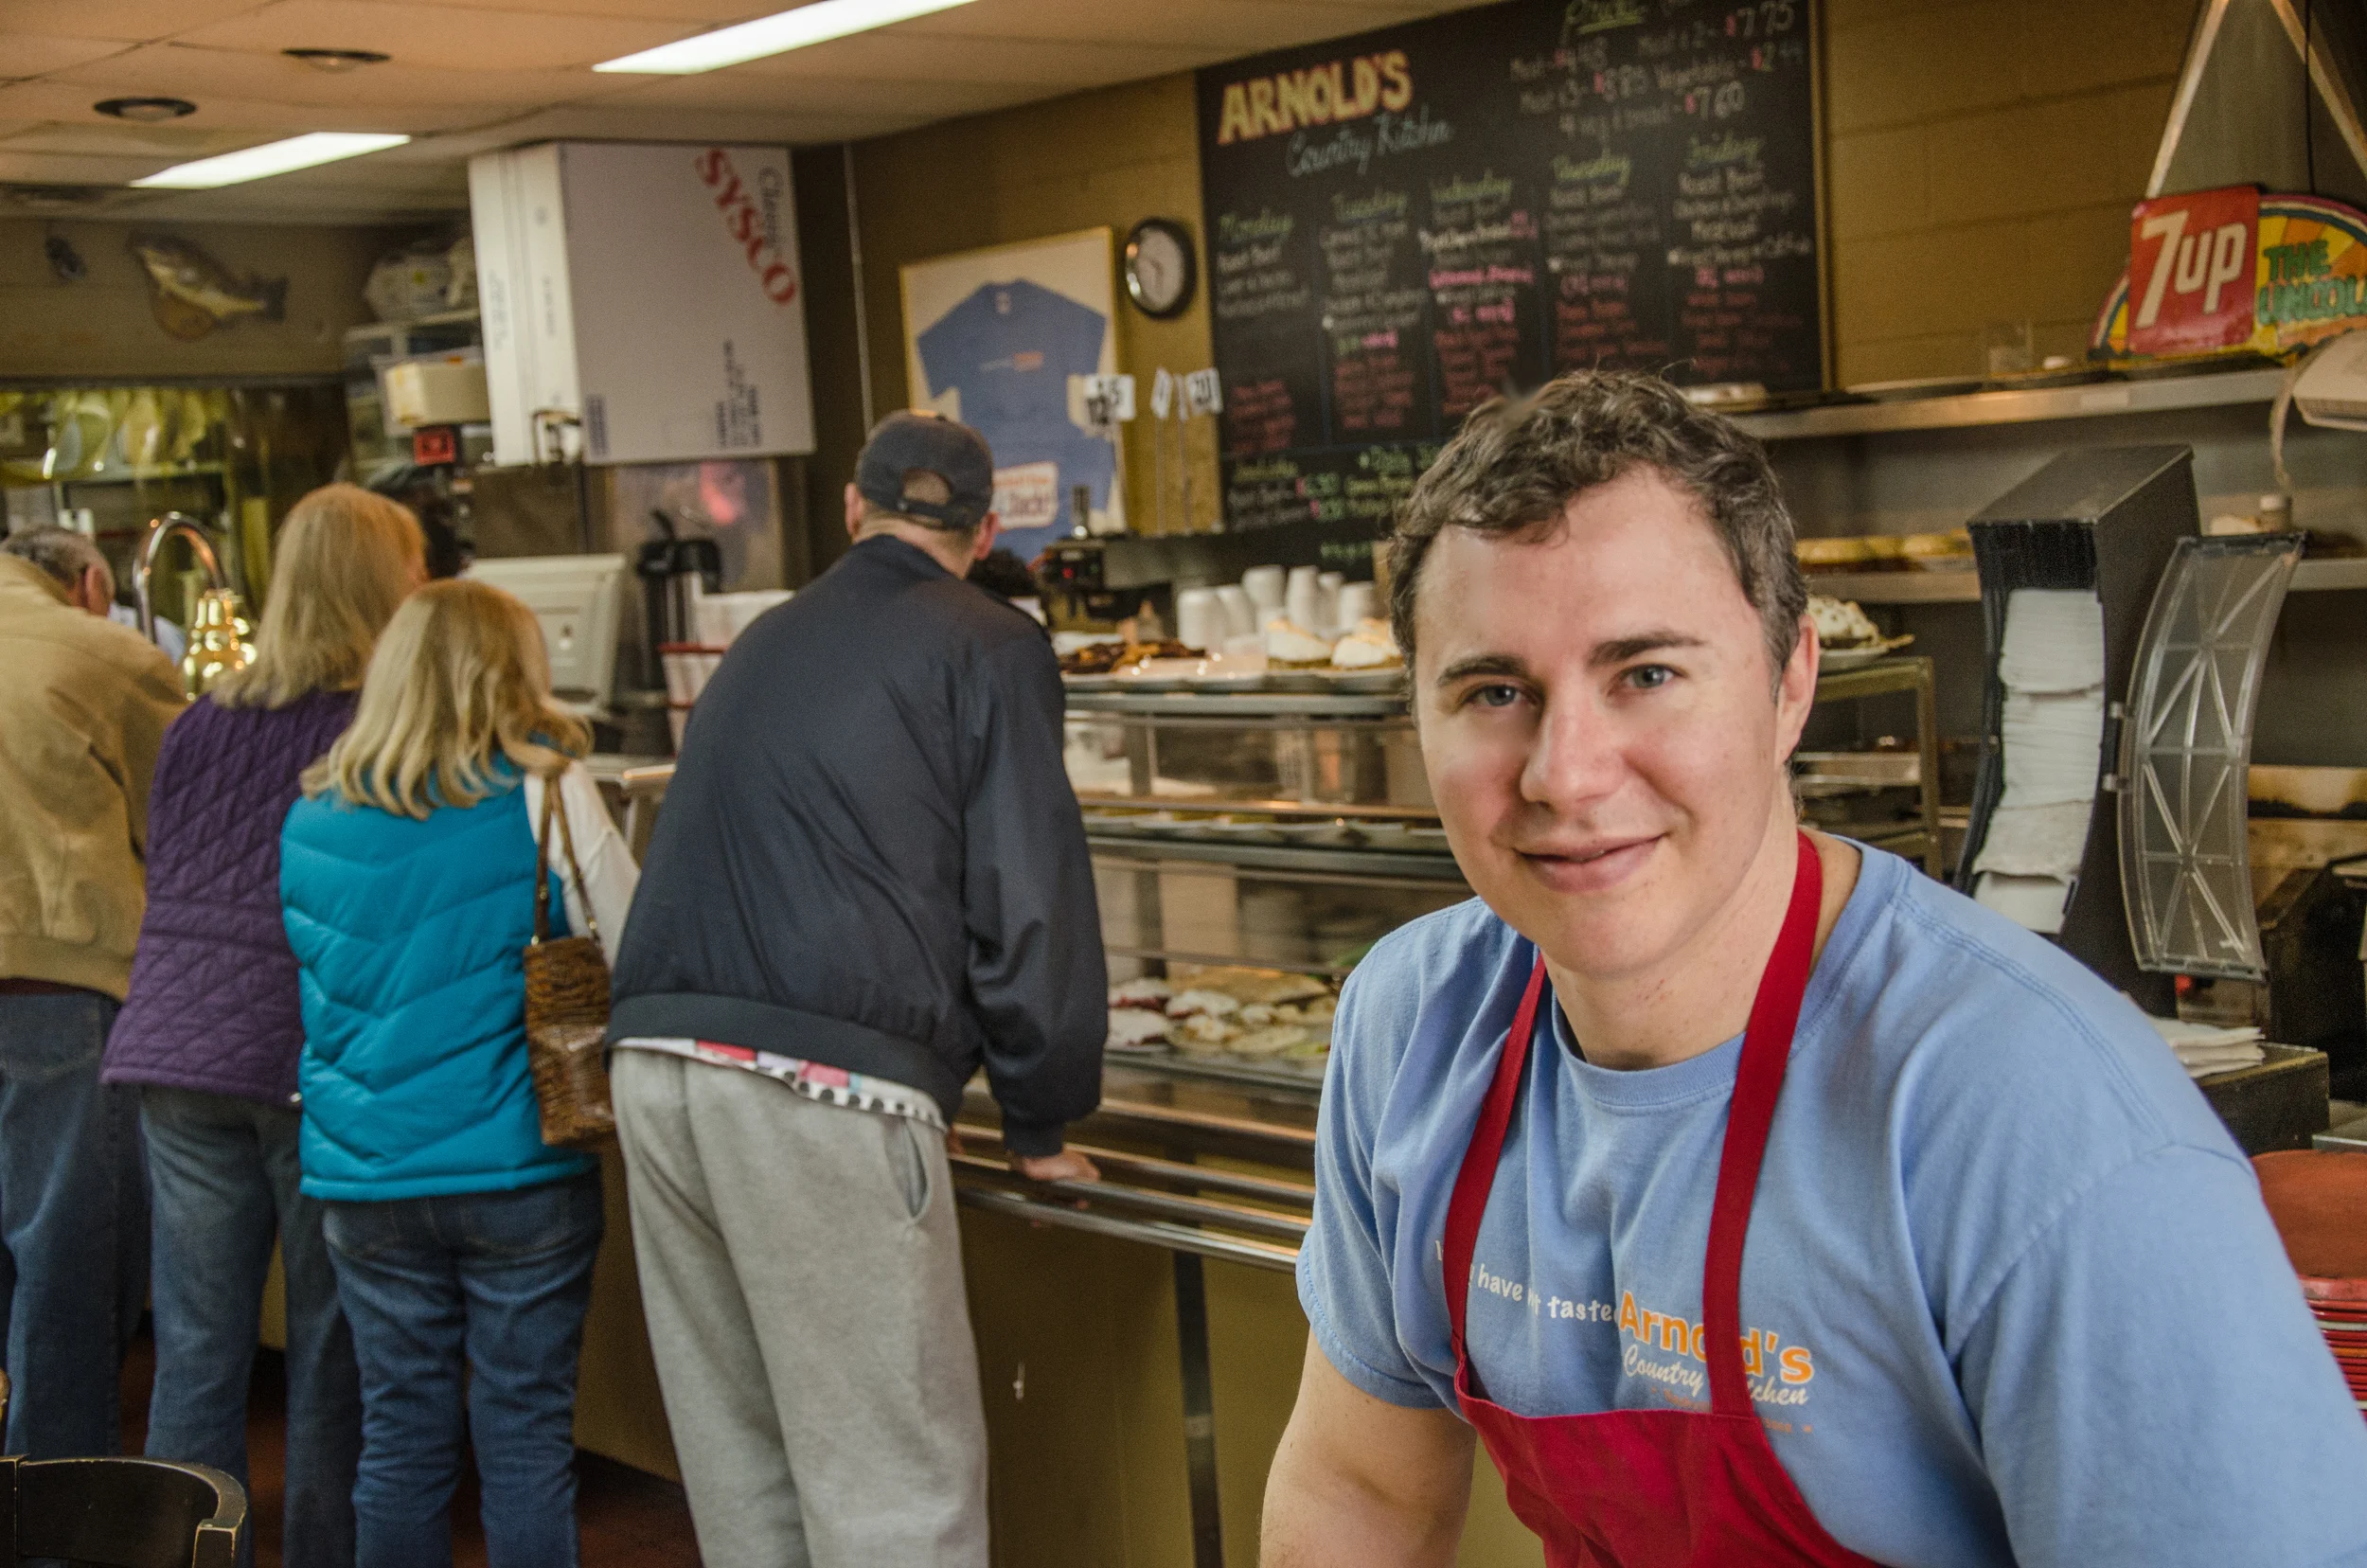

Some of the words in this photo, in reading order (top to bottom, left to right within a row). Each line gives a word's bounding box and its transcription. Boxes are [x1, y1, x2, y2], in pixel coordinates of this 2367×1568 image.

[1216, 49, 1413, 145] ARNOLD'S
[1286, 125, 1373, 178] Country
[693, 147, 797, 306] SYSCO
[2263, 239, 2331, 281] THE
[1477, 1262, 1523, 1302] have
[1618, 1289, 1815, 1385] Arnod's
[1623, 1344, 1703, 1399] Country
